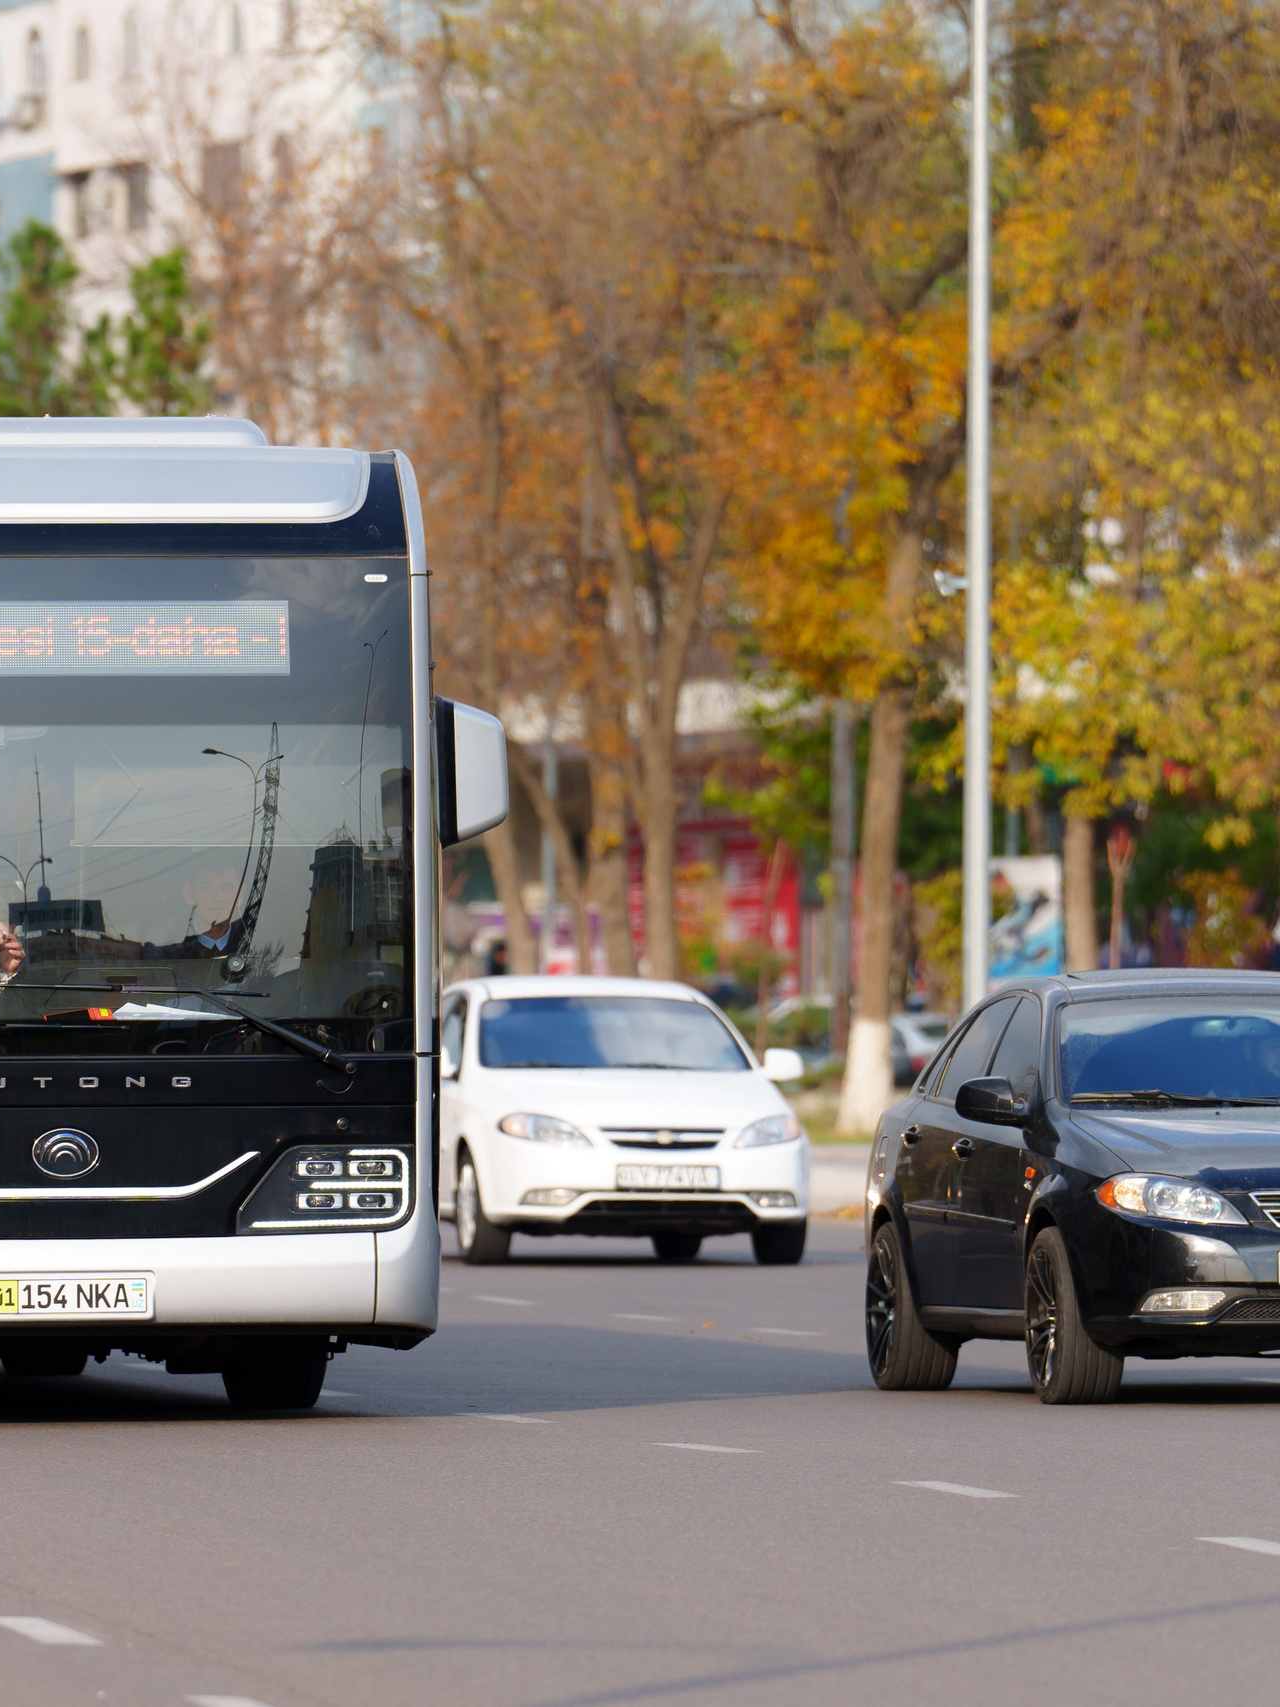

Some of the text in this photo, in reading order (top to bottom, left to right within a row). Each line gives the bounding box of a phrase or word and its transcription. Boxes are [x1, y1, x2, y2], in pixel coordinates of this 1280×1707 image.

[21, 1284, 68, 1309] 154
[76, 1283, 130, 1309] NKA
[131, 1299, 144, 1308] UZ
